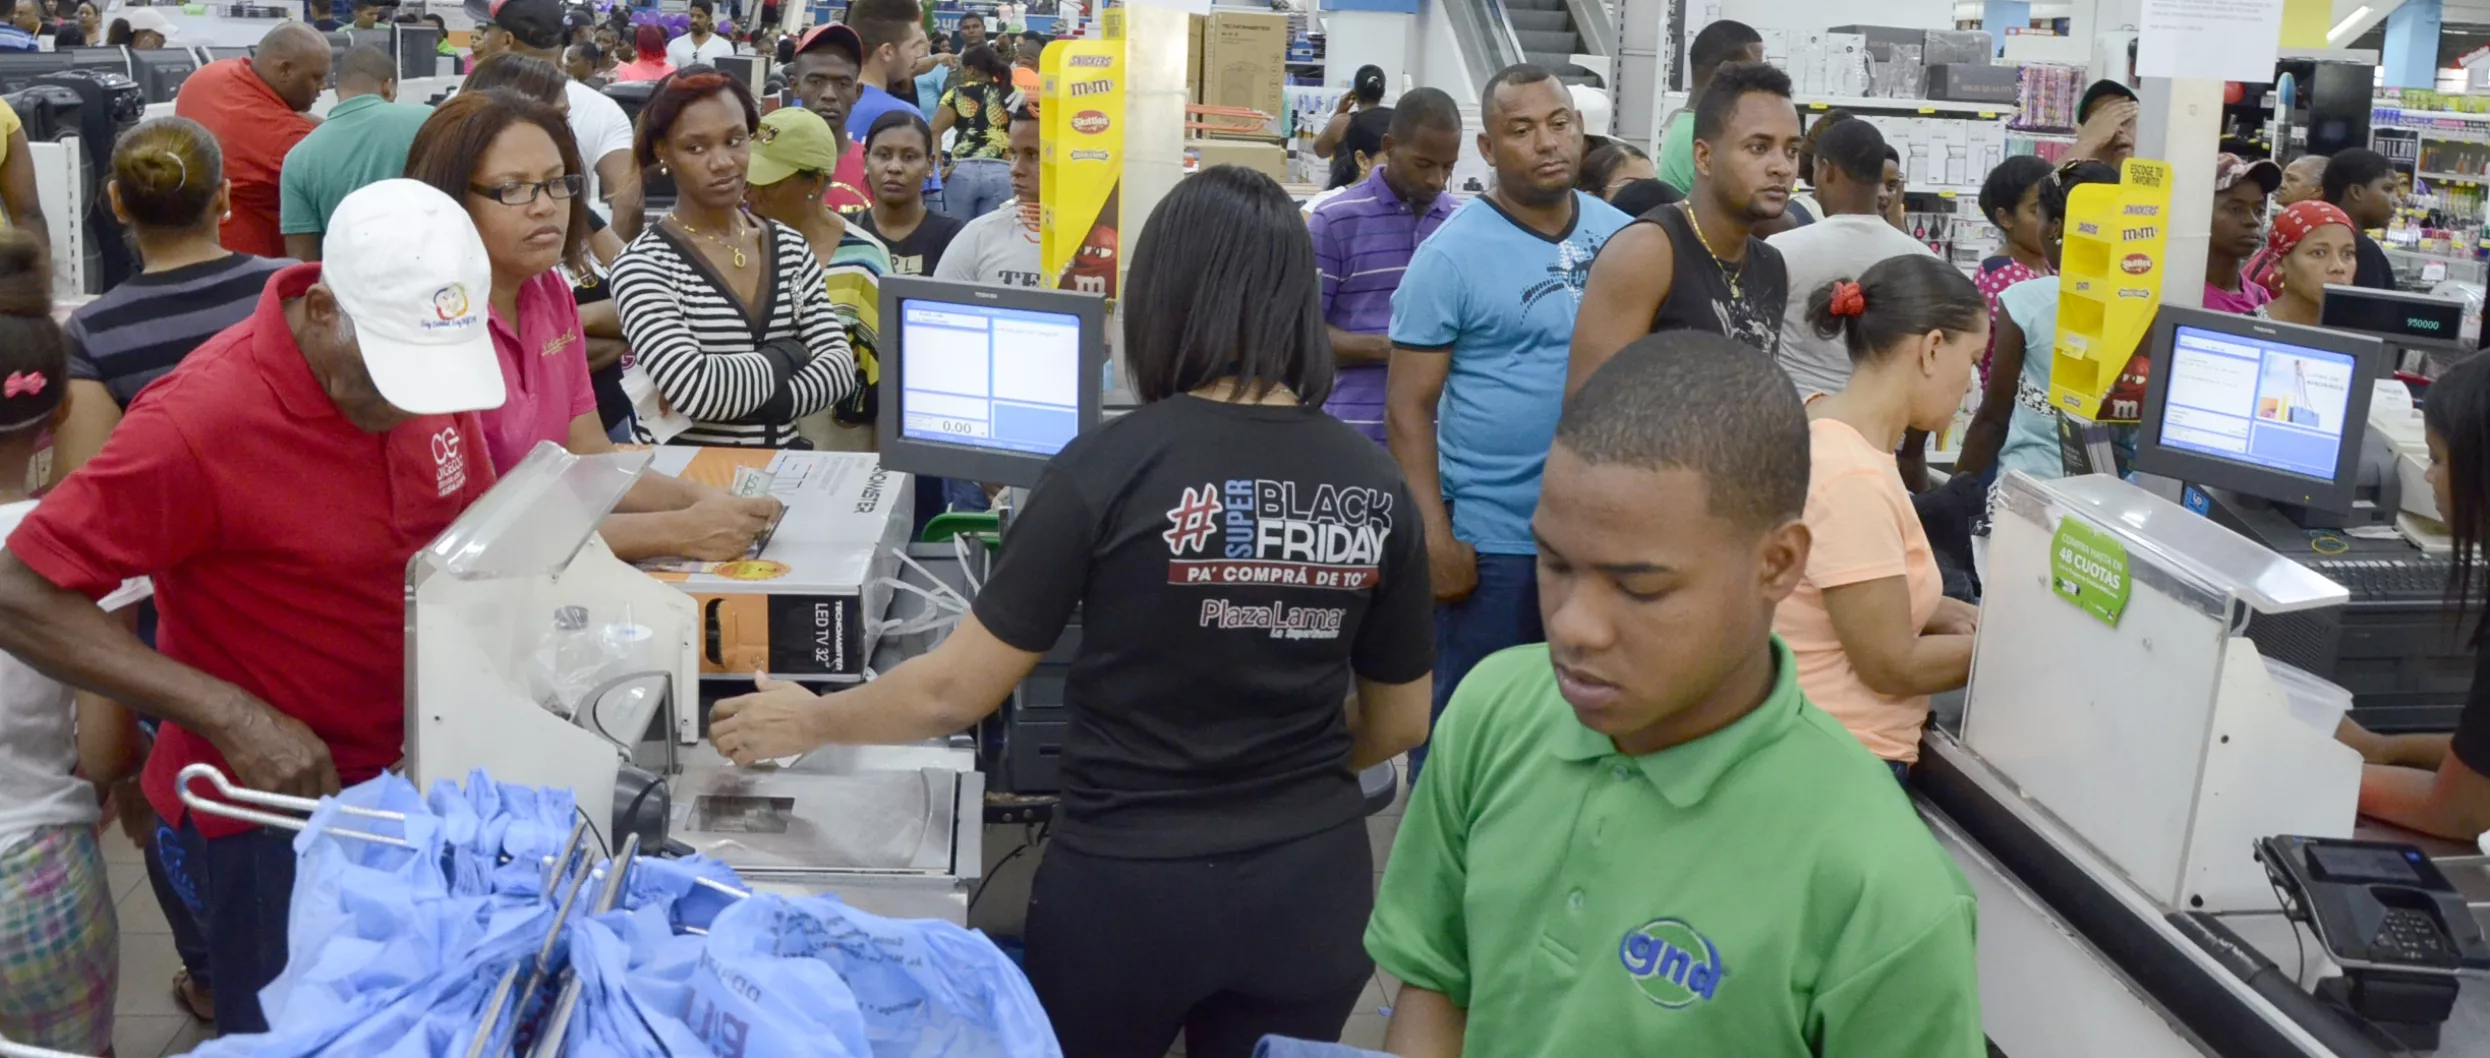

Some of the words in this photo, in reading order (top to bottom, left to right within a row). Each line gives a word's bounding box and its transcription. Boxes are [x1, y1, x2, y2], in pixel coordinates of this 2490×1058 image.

[2407, 317, 2440, 330] 950000
[942, 420, 972, 434] 0.00
[1224, 479, 1254, 559] SUPER
[1255, 479, 1393, 530] BLACK
[1256, 520, 1391, 565] FRIDAY
[1223, 566, 1308, 584] COMPRÁ
[1316, 570, 1338, 586] DE
[2059, 547, 2073, 563] 48
[2074, 554, 2121, 590] CUOTAS
[815, 603, 828, 627] LED
[815, 628, 829, 646] TV
[1619, 932, 1722, 1001] gnd
